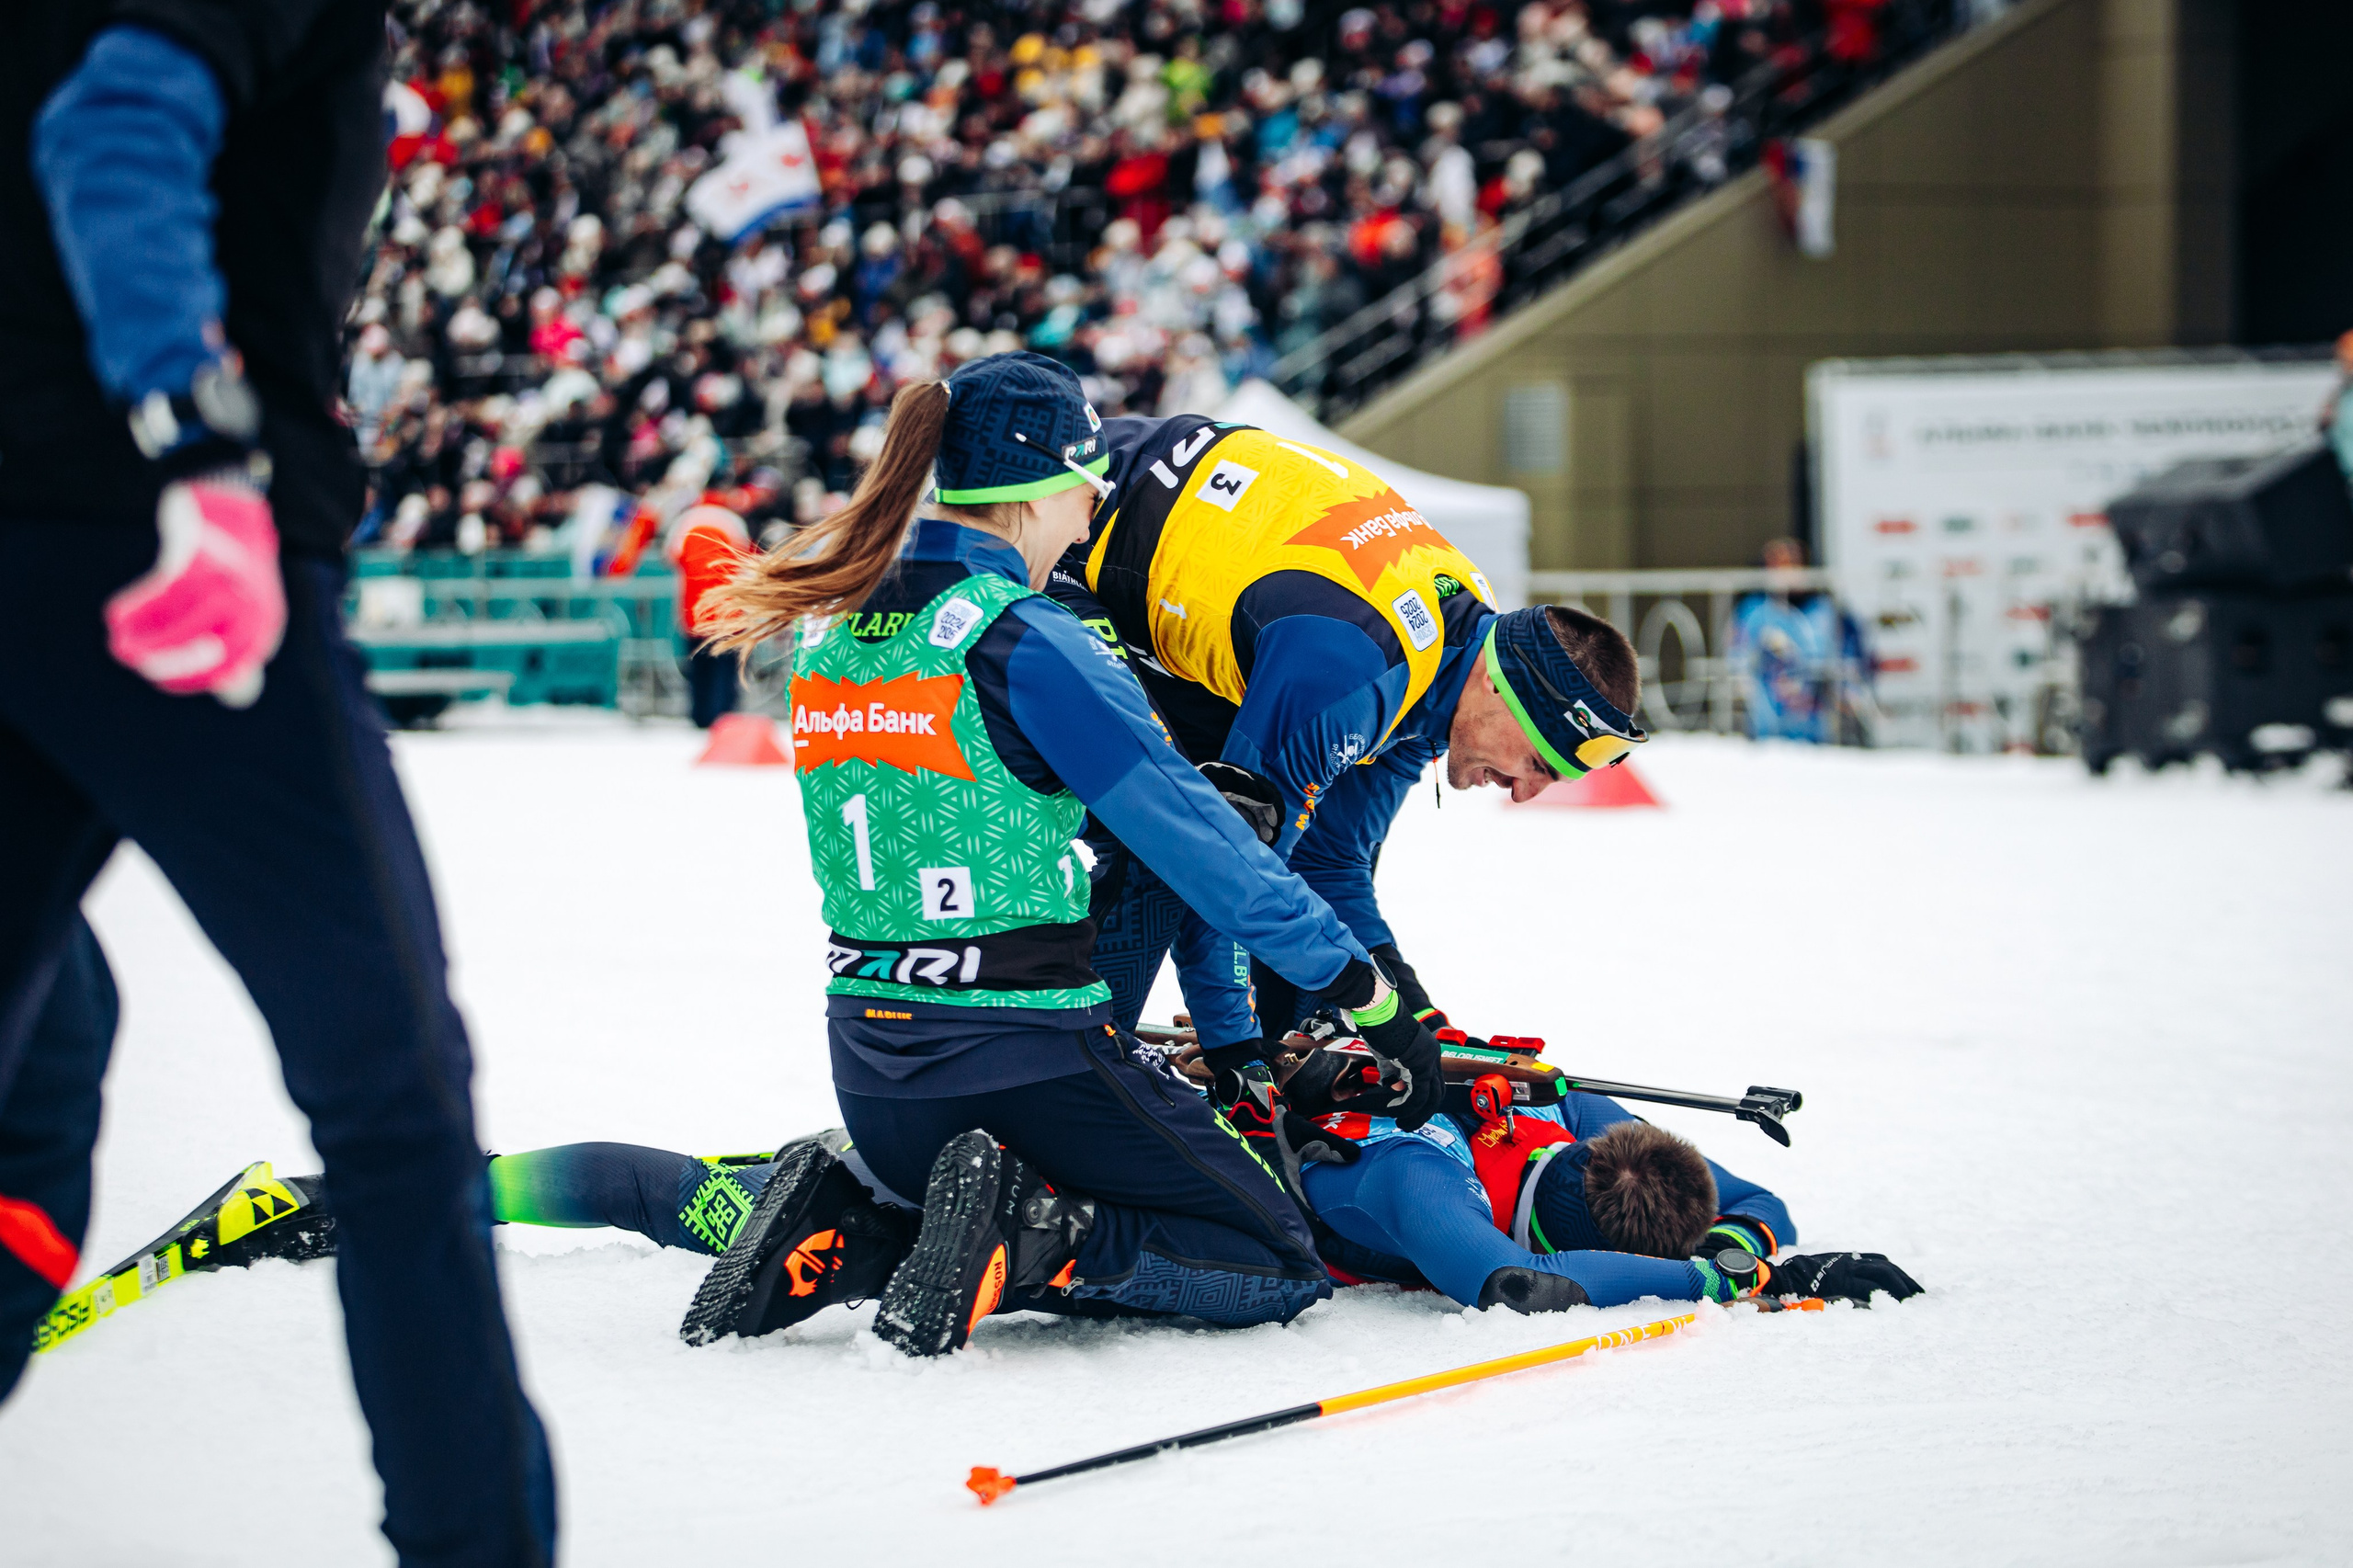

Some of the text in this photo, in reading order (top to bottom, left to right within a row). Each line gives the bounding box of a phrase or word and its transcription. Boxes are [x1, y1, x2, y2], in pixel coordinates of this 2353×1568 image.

[1211, 472, 1242, 495] 3
[1339, 514, 1397, 551] Банк
[1400, 597, 1421, 619] 2025
[1408, 610, 1428, 631] 2024
[794, 702, 938, 740] Альфа Банк
[842, 793, 875, 892] 1
[937, 878, 959, 913] 2
[1441, 1050, 1505, 1064] BELORUSNEFT
